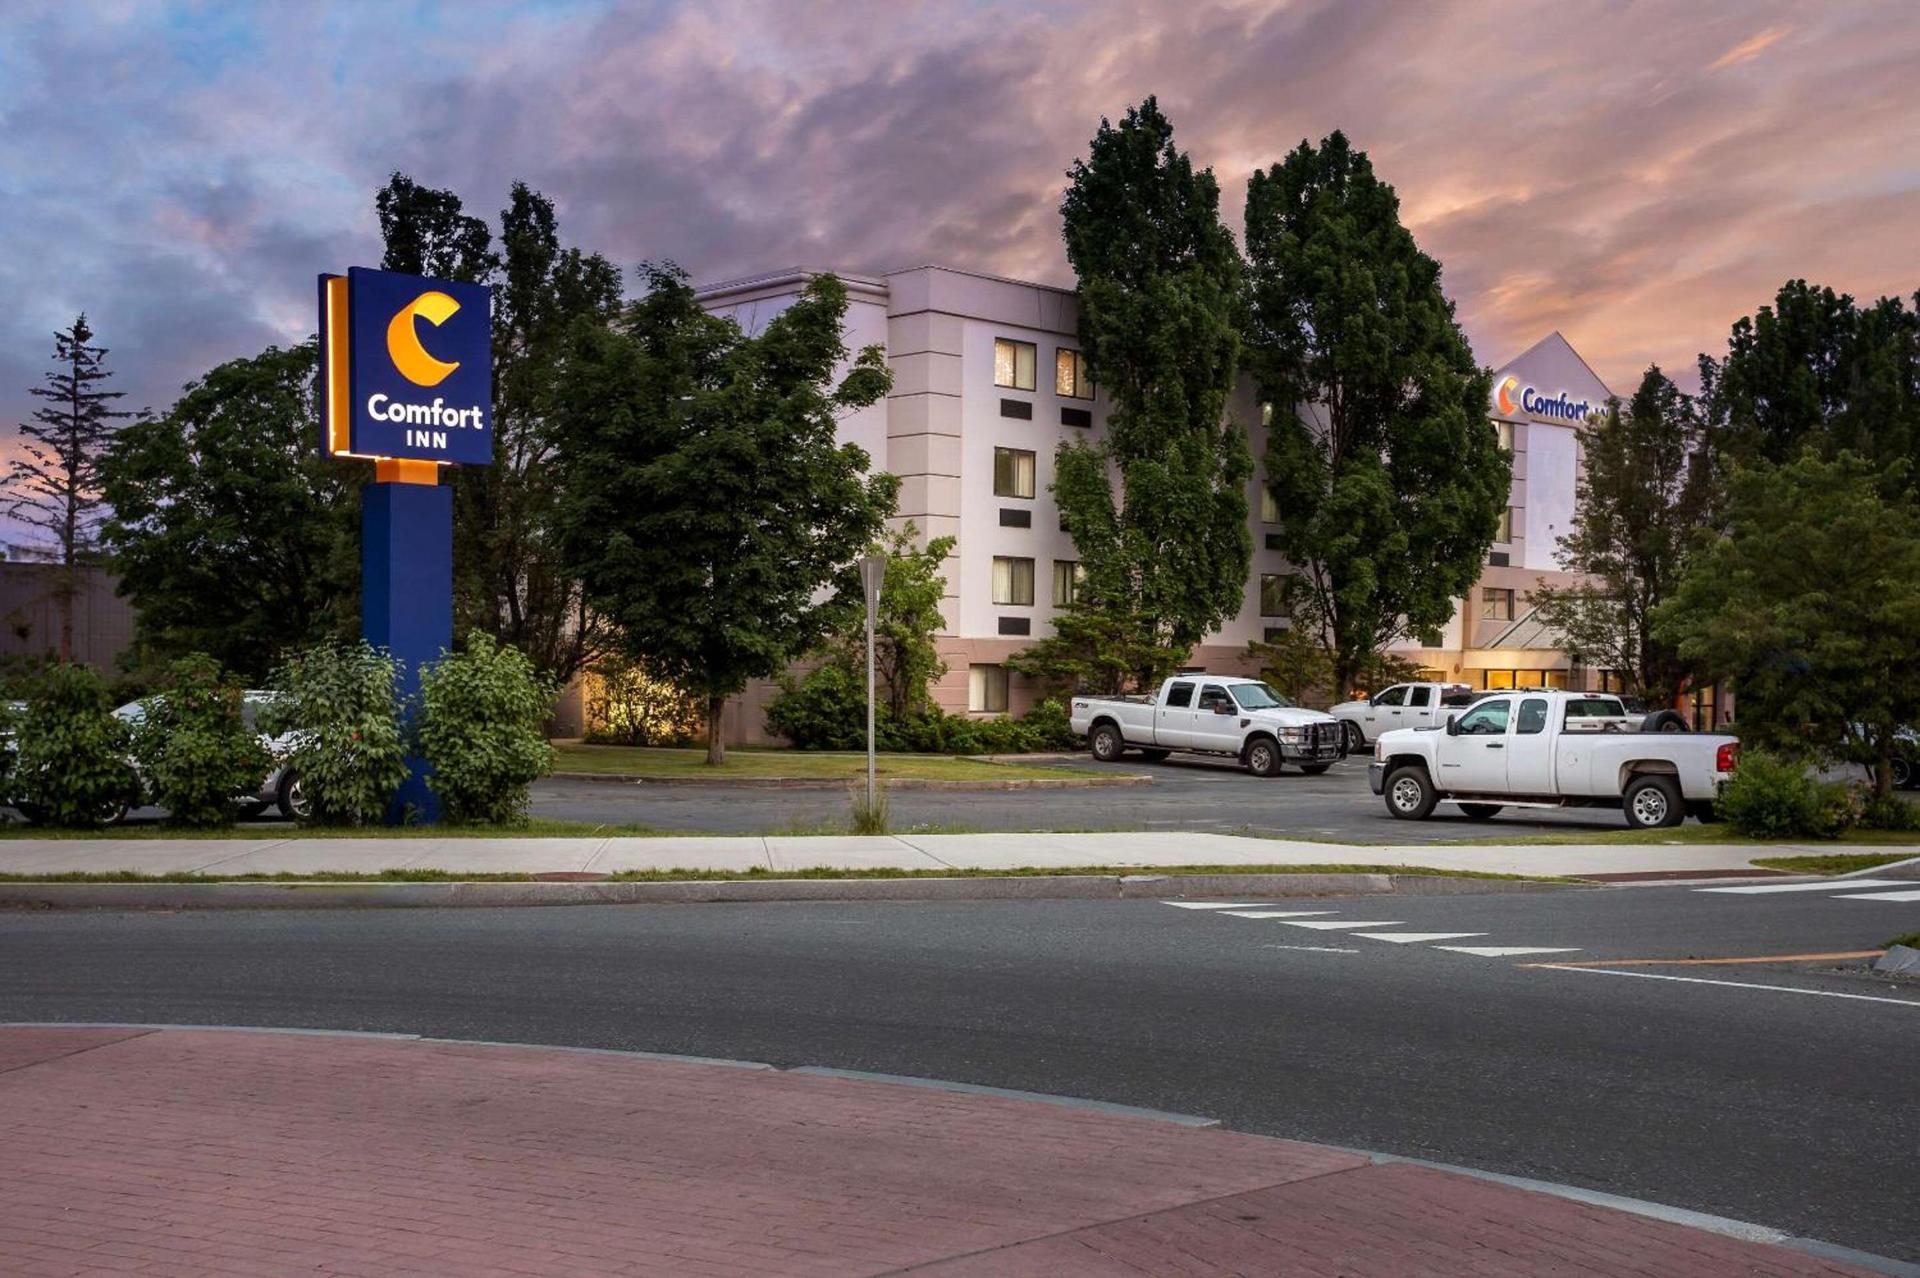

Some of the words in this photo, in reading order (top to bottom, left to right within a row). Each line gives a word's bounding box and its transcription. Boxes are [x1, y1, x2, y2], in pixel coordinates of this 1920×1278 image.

[368, 393, 483, 430] Comfort
[1521, 386, 1589, 421] Comfort
[406, 430, 447, 449] INN
